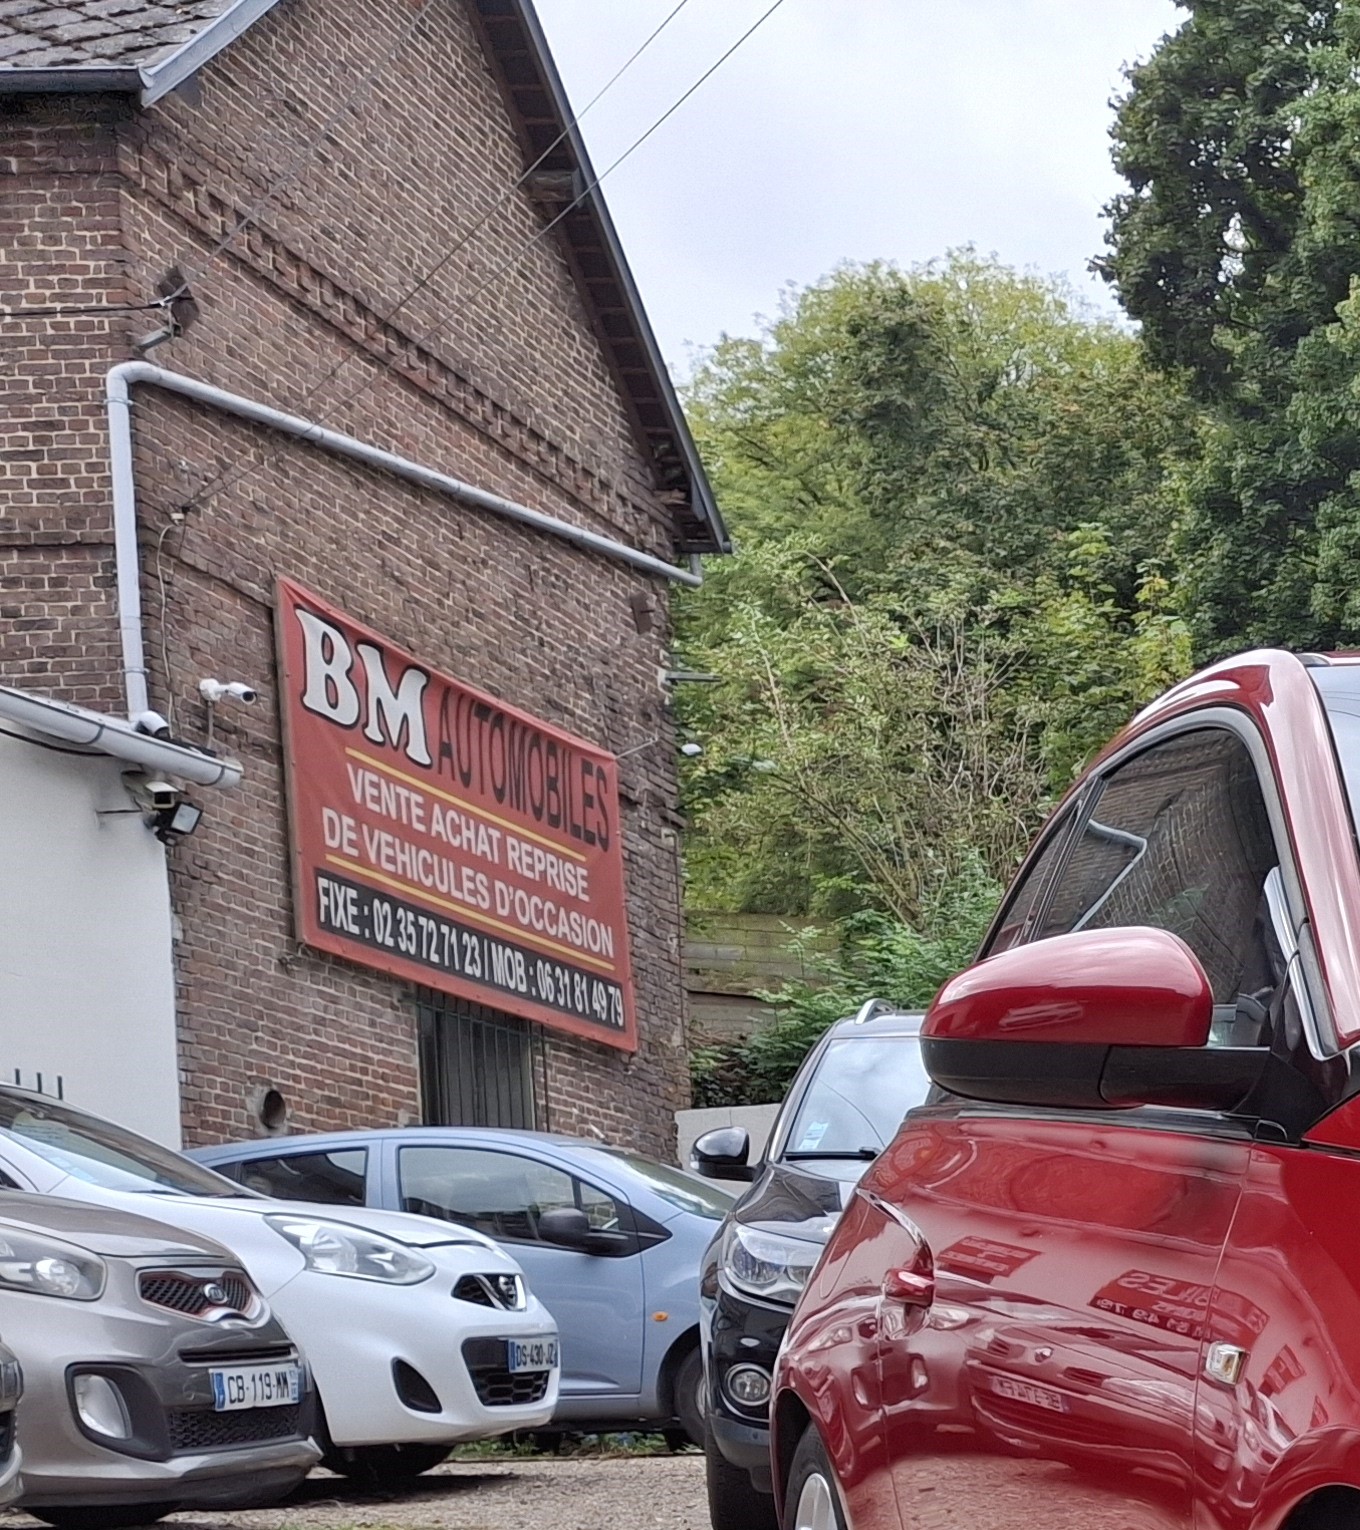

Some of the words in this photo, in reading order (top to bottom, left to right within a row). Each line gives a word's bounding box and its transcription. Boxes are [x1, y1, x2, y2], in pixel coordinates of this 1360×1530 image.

[293, 603, 433, 768] BM
[438, 687, 610, 852] AUTOMOBILES
[322, 807, 359, 857] DE
[362, 823, 490, 910] VEHICULES
[494, 879, 614, 959] D'OCCASION
[346, 762, 427, 833] VENTE
[431, 803, 501, 864] ACHAT
[506, 835, 590, 902] REPRISE
[318, 876, 360, 935] FIXE
[373, 898, 394, 947] 02
[397, 907, 416, 955] 35
[418, 915, 440, 963] 72
[441, 924, 459, 970] 71
[462, 932, 481, 978] 23
[491, 942, 527, 993] MOB
[536, 959, 555, 1003] 06
[555, 966, 571, 1009] 31
[574, 973, 590, 1015] 81
[592, 980, 607, 1021] 49
[607, 985, 624, 1027] 79
[228, 1371, 289, 1404] CB-119-MM
